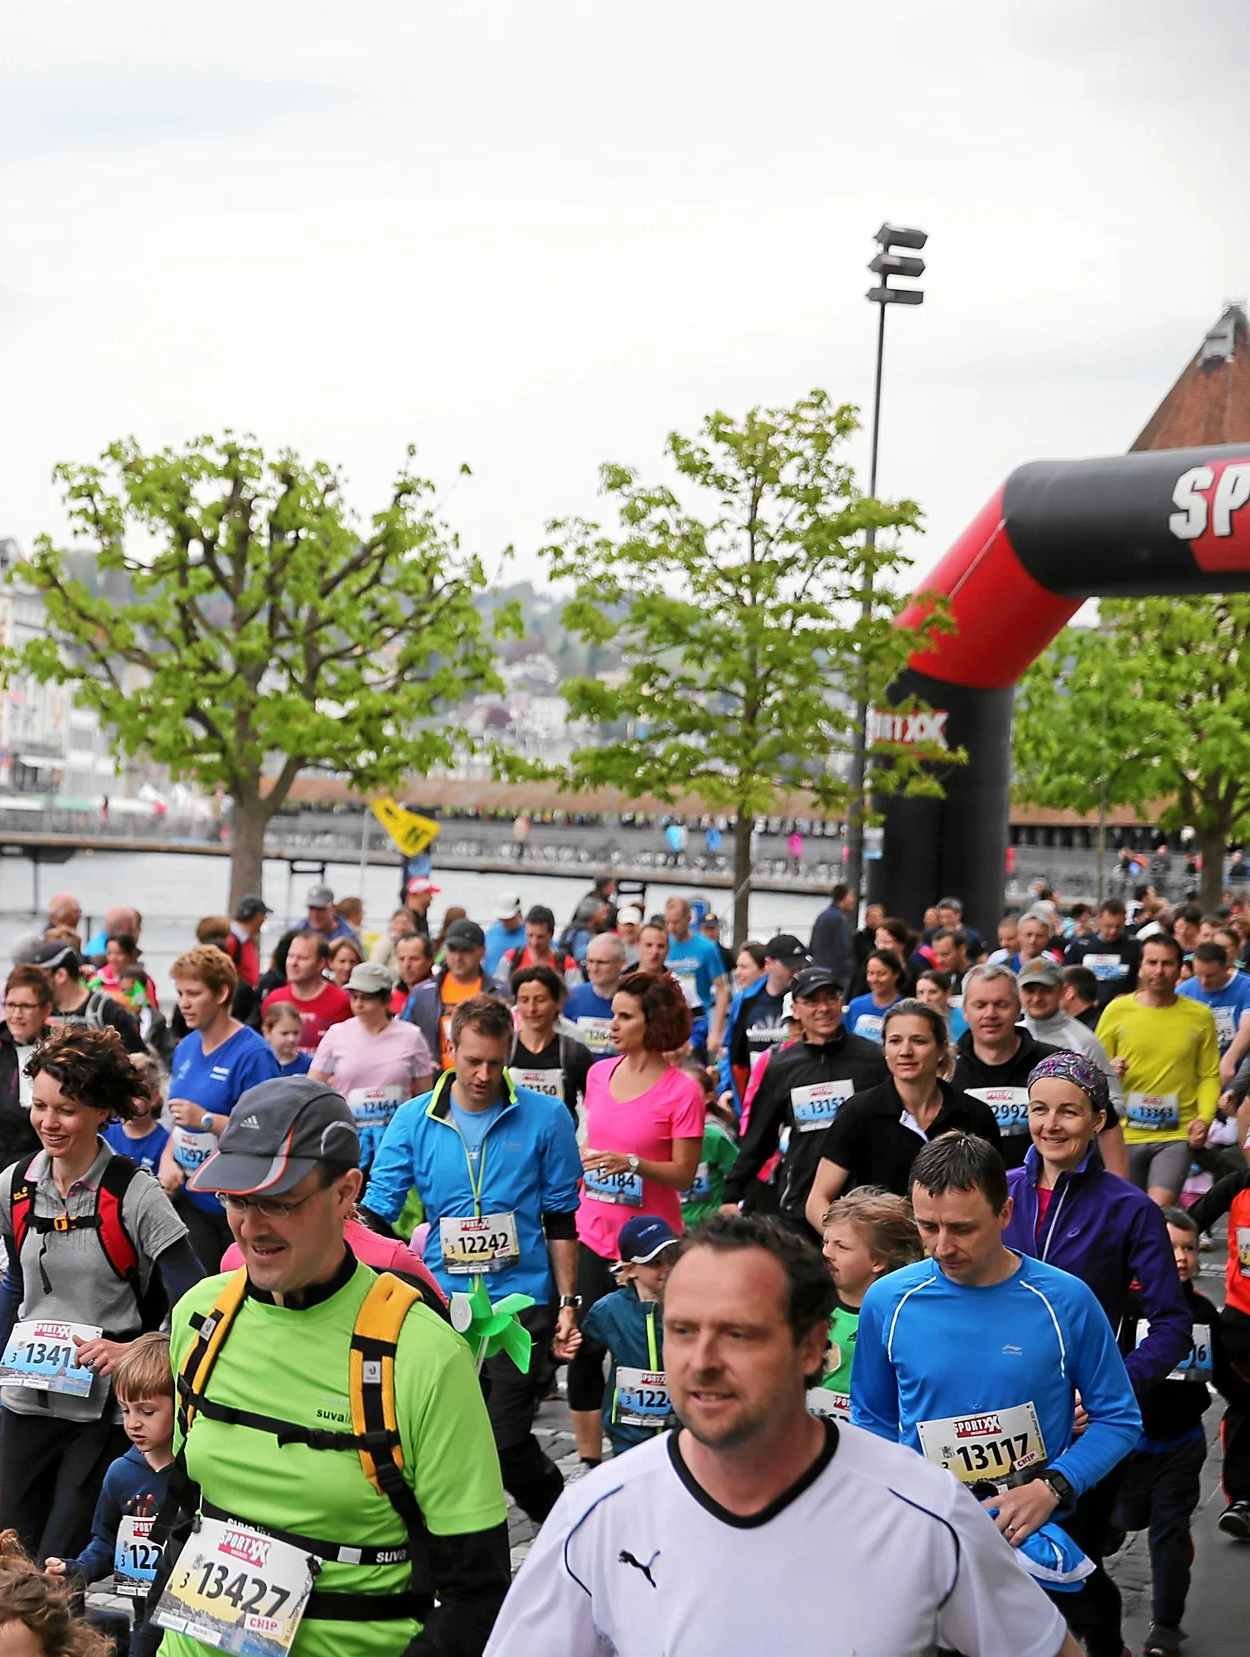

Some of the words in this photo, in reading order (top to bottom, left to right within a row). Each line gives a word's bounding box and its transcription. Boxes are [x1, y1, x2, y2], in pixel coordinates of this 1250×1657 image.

[1169, 463, 1250, 539] SP
[458, 1232, 510, 1254] 12242
[11, 1352, 17, 1363] 3
[26, 1343, 81, 1369] 1341
[636, 1390, 671, 1407] 122
[953, 1415, 1002, 1433] SPORTXX
[957, 1433, 1028, 1472] 13117
[1018, 1453, 1035, 1468] CHIP
[220, 1530, 271, 1564] SPORTXX
[121, 1554, 126, 1567] 3
[180, 1572, 190, 1588] 3
[197, 1562, 291, 1618] 13427
[250, 1617, 278, 1631] CHIP
